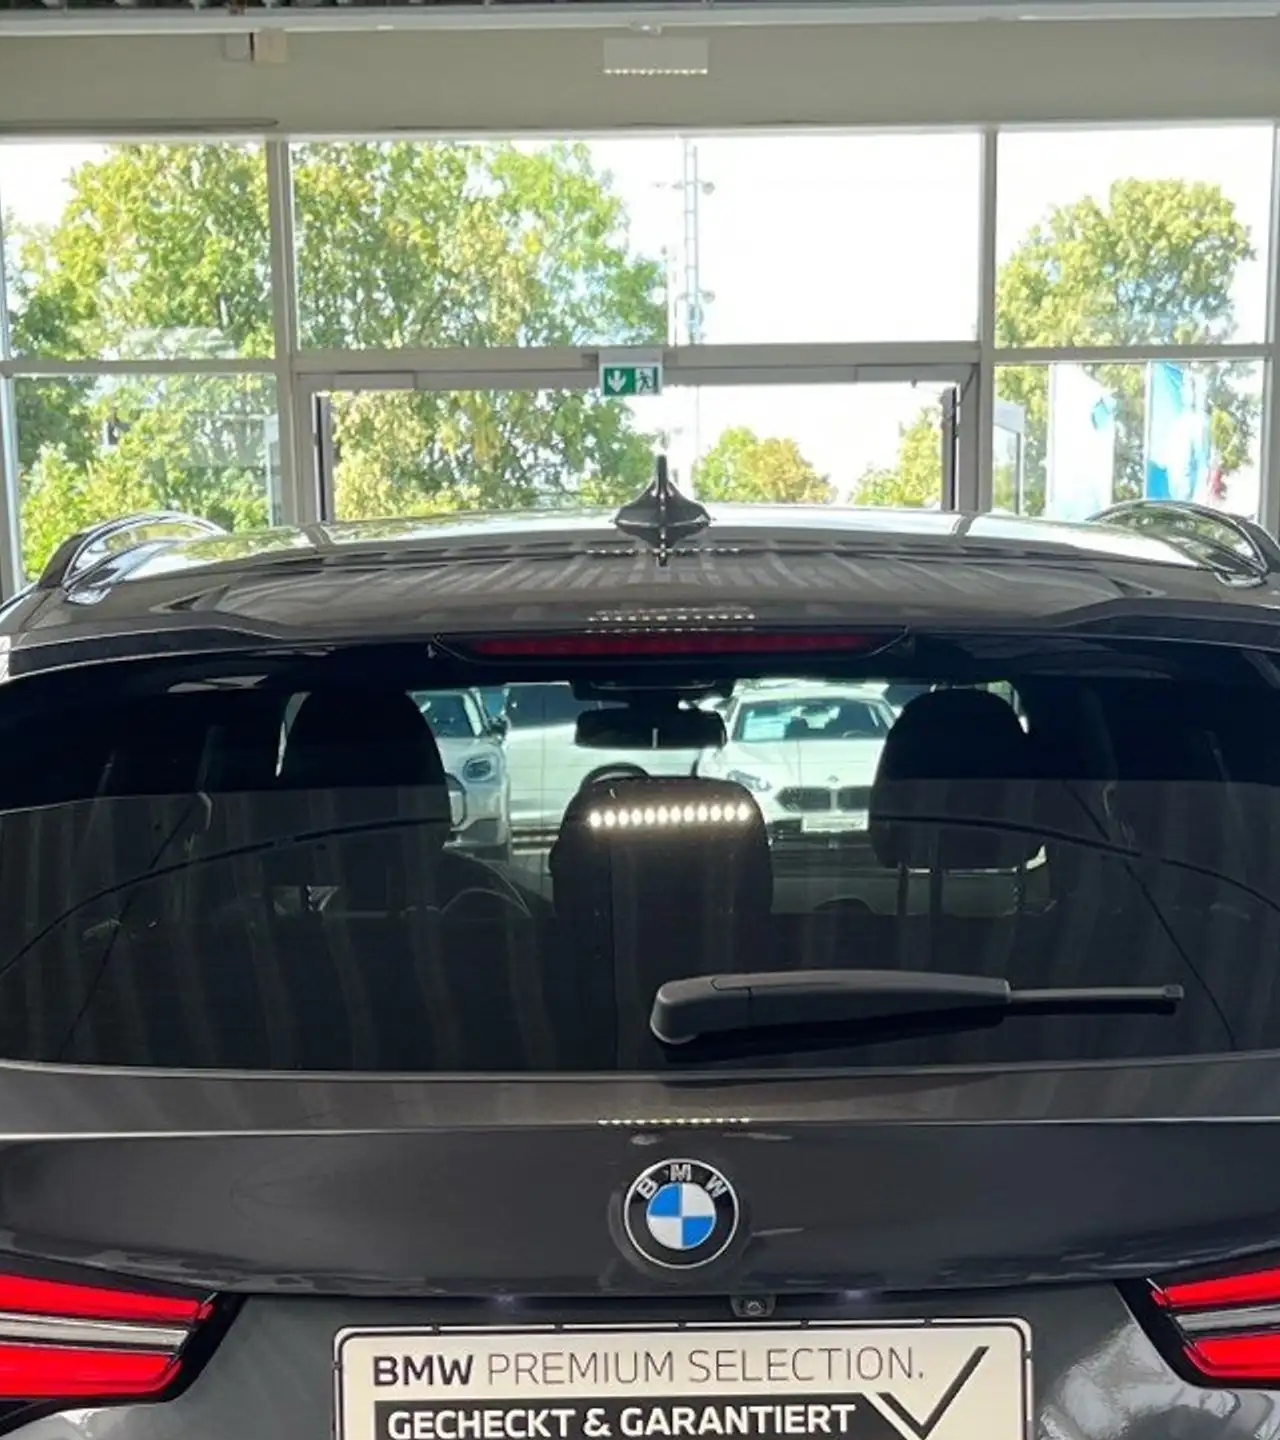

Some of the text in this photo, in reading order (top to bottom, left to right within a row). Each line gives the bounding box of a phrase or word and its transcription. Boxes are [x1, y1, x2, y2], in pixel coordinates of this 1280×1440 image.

[635, 1163, 728, 1200] BMW
[372, 1346, 925, 1387] BMW PREMIUM SELECTION.
[387, 1403, 857, 1440] GECHECKT & GARANTIERT
